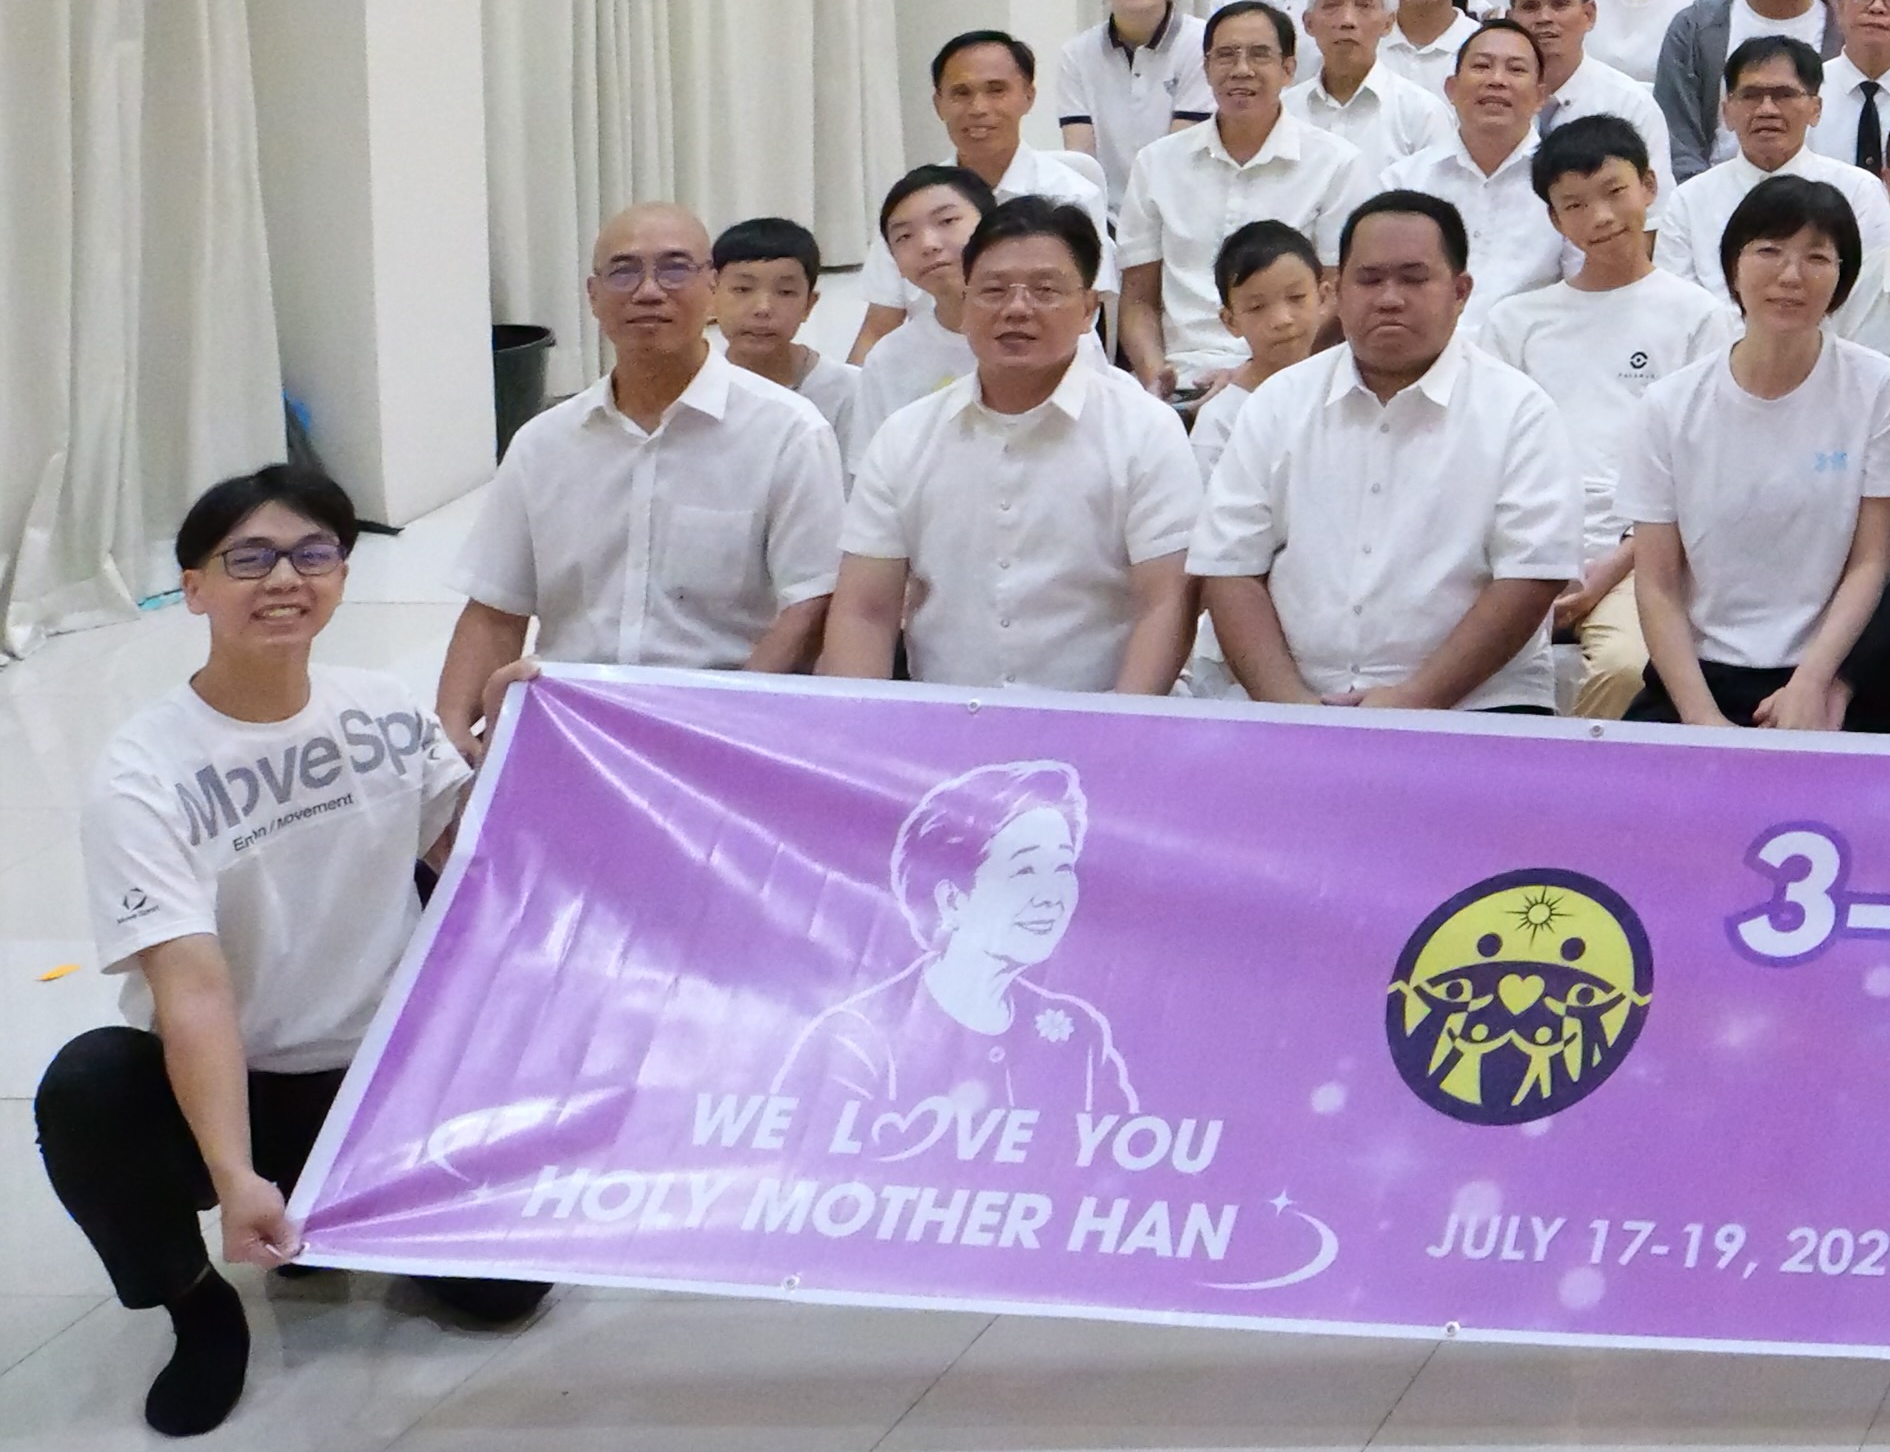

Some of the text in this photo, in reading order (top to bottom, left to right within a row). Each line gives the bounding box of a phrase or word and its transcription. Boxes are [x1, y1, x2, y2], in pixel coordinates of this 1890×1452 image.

[692, 1092, 798, 1150] WE
[1075, 1111, 1224, 1173] YOU
[521, 1164, 1240, 1260] HOLY MOTHER HAN
[1426, 1213, 1567, 1262] JULY
[1587, 1219, 1759, 1280] 17-19,
